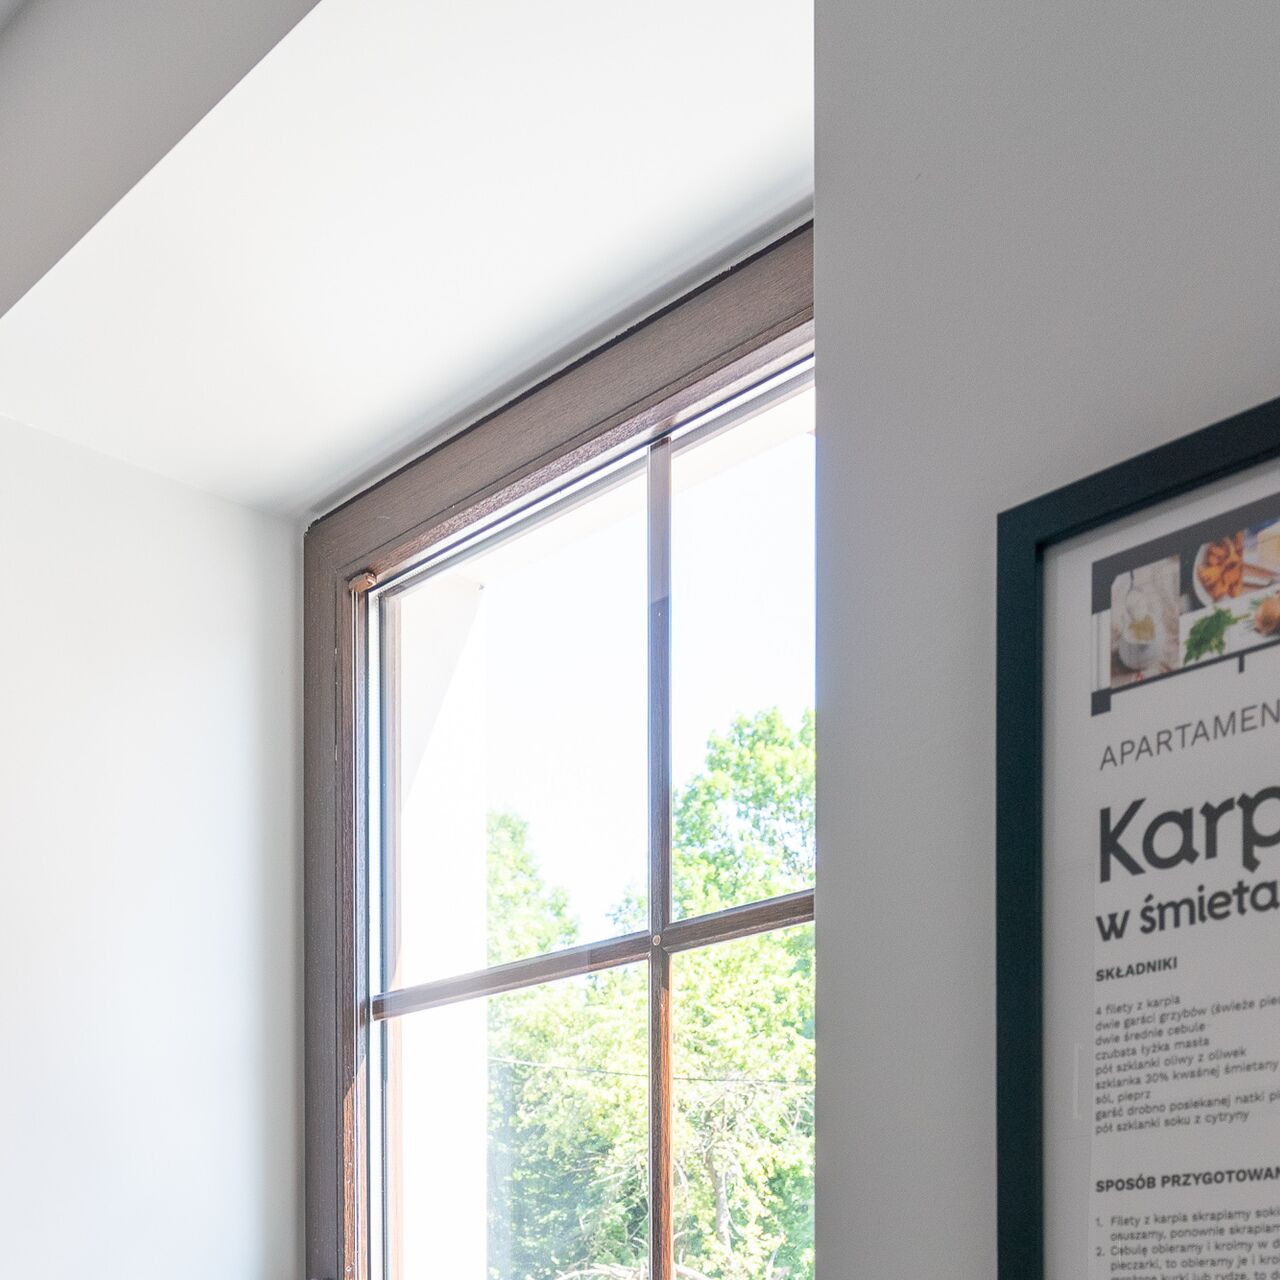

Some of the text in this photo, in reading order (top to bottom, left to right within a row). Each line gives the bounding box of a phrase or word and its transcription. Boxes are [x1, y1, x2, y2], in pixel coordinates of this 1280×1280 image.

[1096, 911, 1130, 942] w
[1095, 956, 1178, 981] SKŁADNIKI
[1094, 992, 1180, 1016] 4 filety z karpia
[1094, 1016, 1120, 1030] dwie
[1122, 1011, 1155, 1029] garści
[1158, 1003, 1207, 1023] grzybów
[1094, 1020, 1206, 1045] dwie średnie cebule
[1094, 1034, 1210, 1059] czubata łyżka masła
[1094, 1046, 1246, 1077] pół szklanki oliwy z oliwek
[1094, 1073, 1142, 1089] szklanka
[1171, 1064, 1220, 1083] kwaśnej
[1223, 1057, 1279, 1078] śmietany
[1094, 1105, 1123, 1121] garść
[1126, 1100, 1166, 1115] drobno
[1168, 1094, 1231, 1113] posiekanej
[1234, 1090, 1264, 1105] natki
[1116, 1088, 1151, 1104] pieprz
[1094, 1109, 1249, 1136] pół szklanki soku z cytryny
[1095, 1173, 1157, 1193] SPOSÓB
[1094, 1216, 1103, 1226] 1.
[1109, 1213, 1140, 1228] Filety
[1143, 1215, 1150, 1223] z
[1152, 1210, 1188, 1225] karpia
[1252, 1269, 1267, 1280] to
